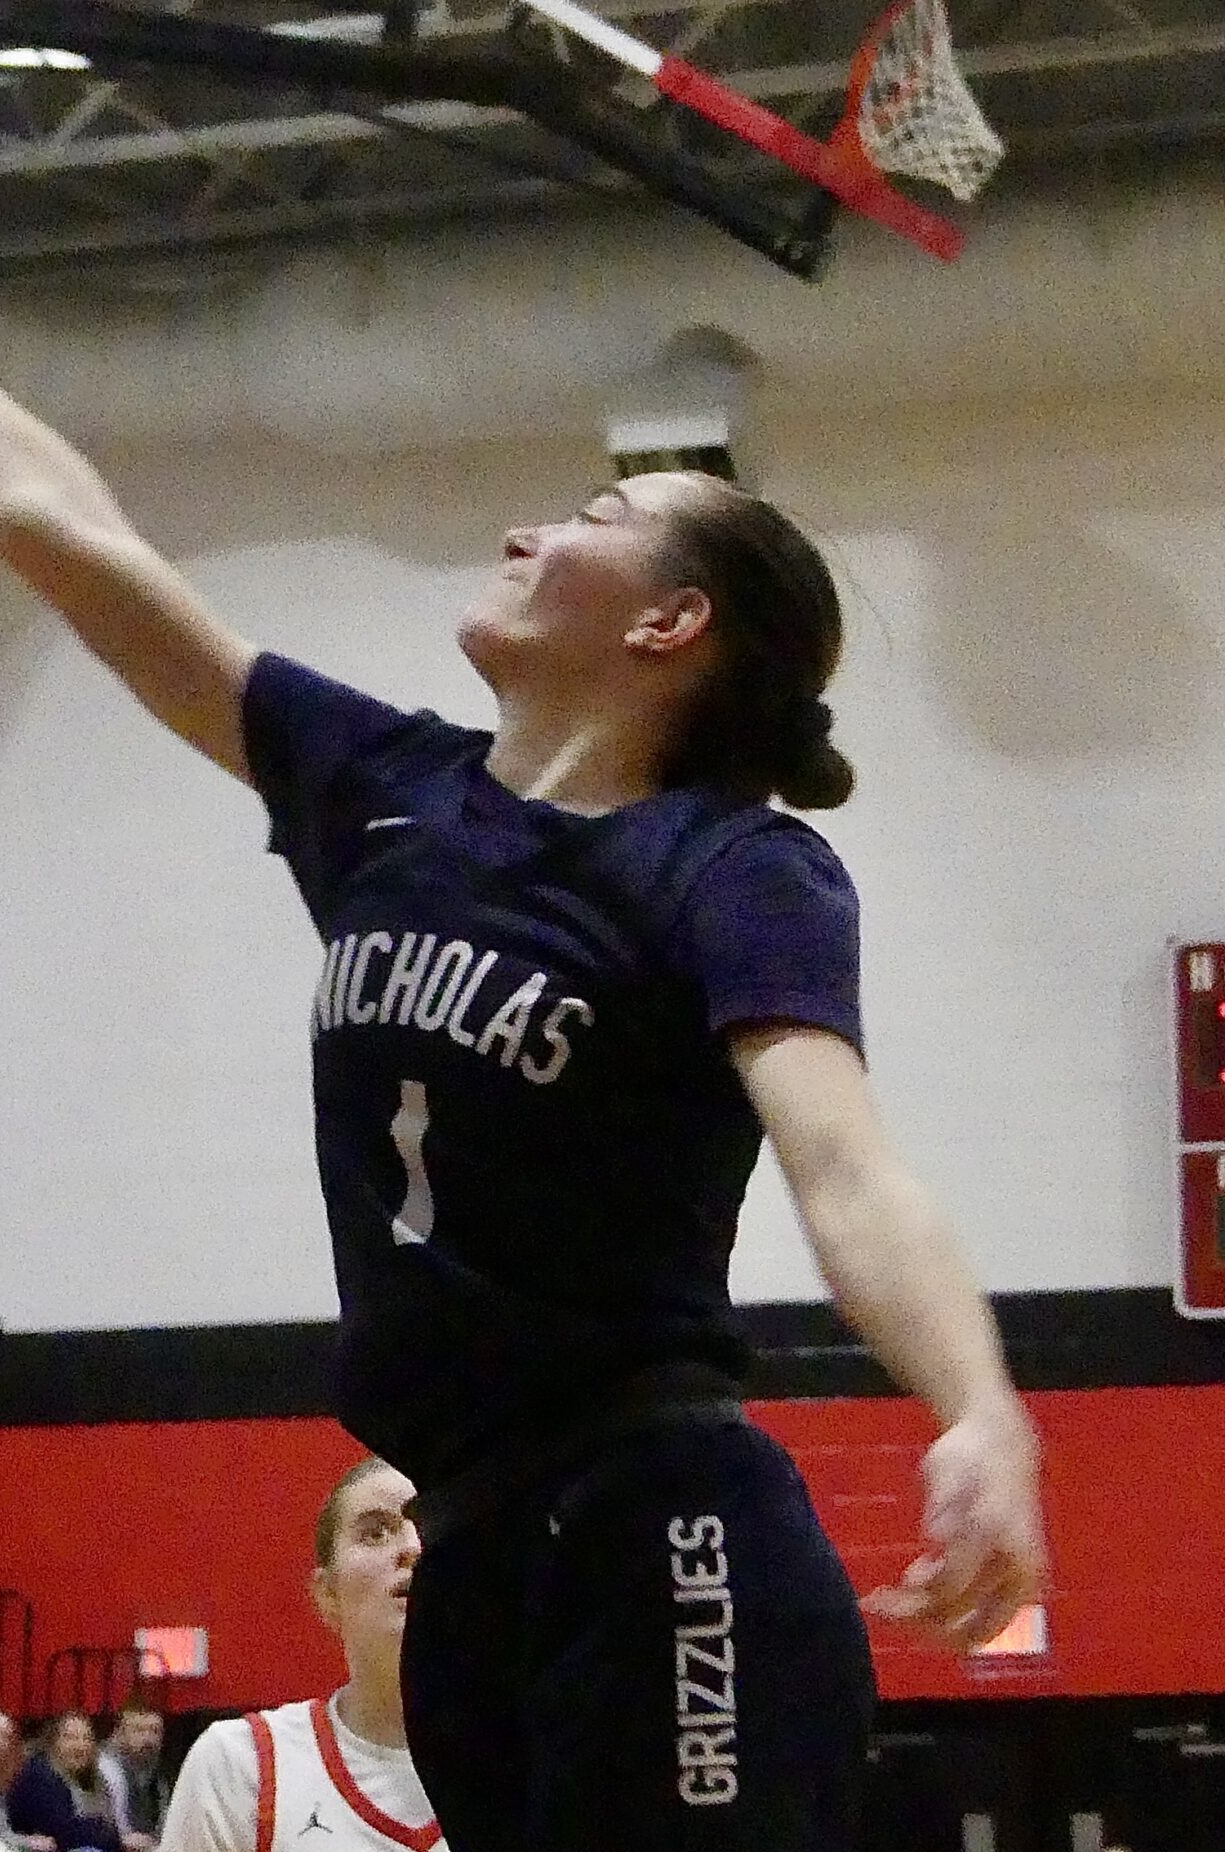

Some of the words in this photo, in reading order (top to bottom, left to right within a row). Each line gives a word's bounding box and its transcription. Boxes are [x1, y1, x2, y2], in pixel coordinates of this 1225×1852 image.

[312, 931, 594, 1085] NICHOLAS
[390, 1079, 434, 1246] 1
[667, 1514, 738, 1807] GRIZZLIES
